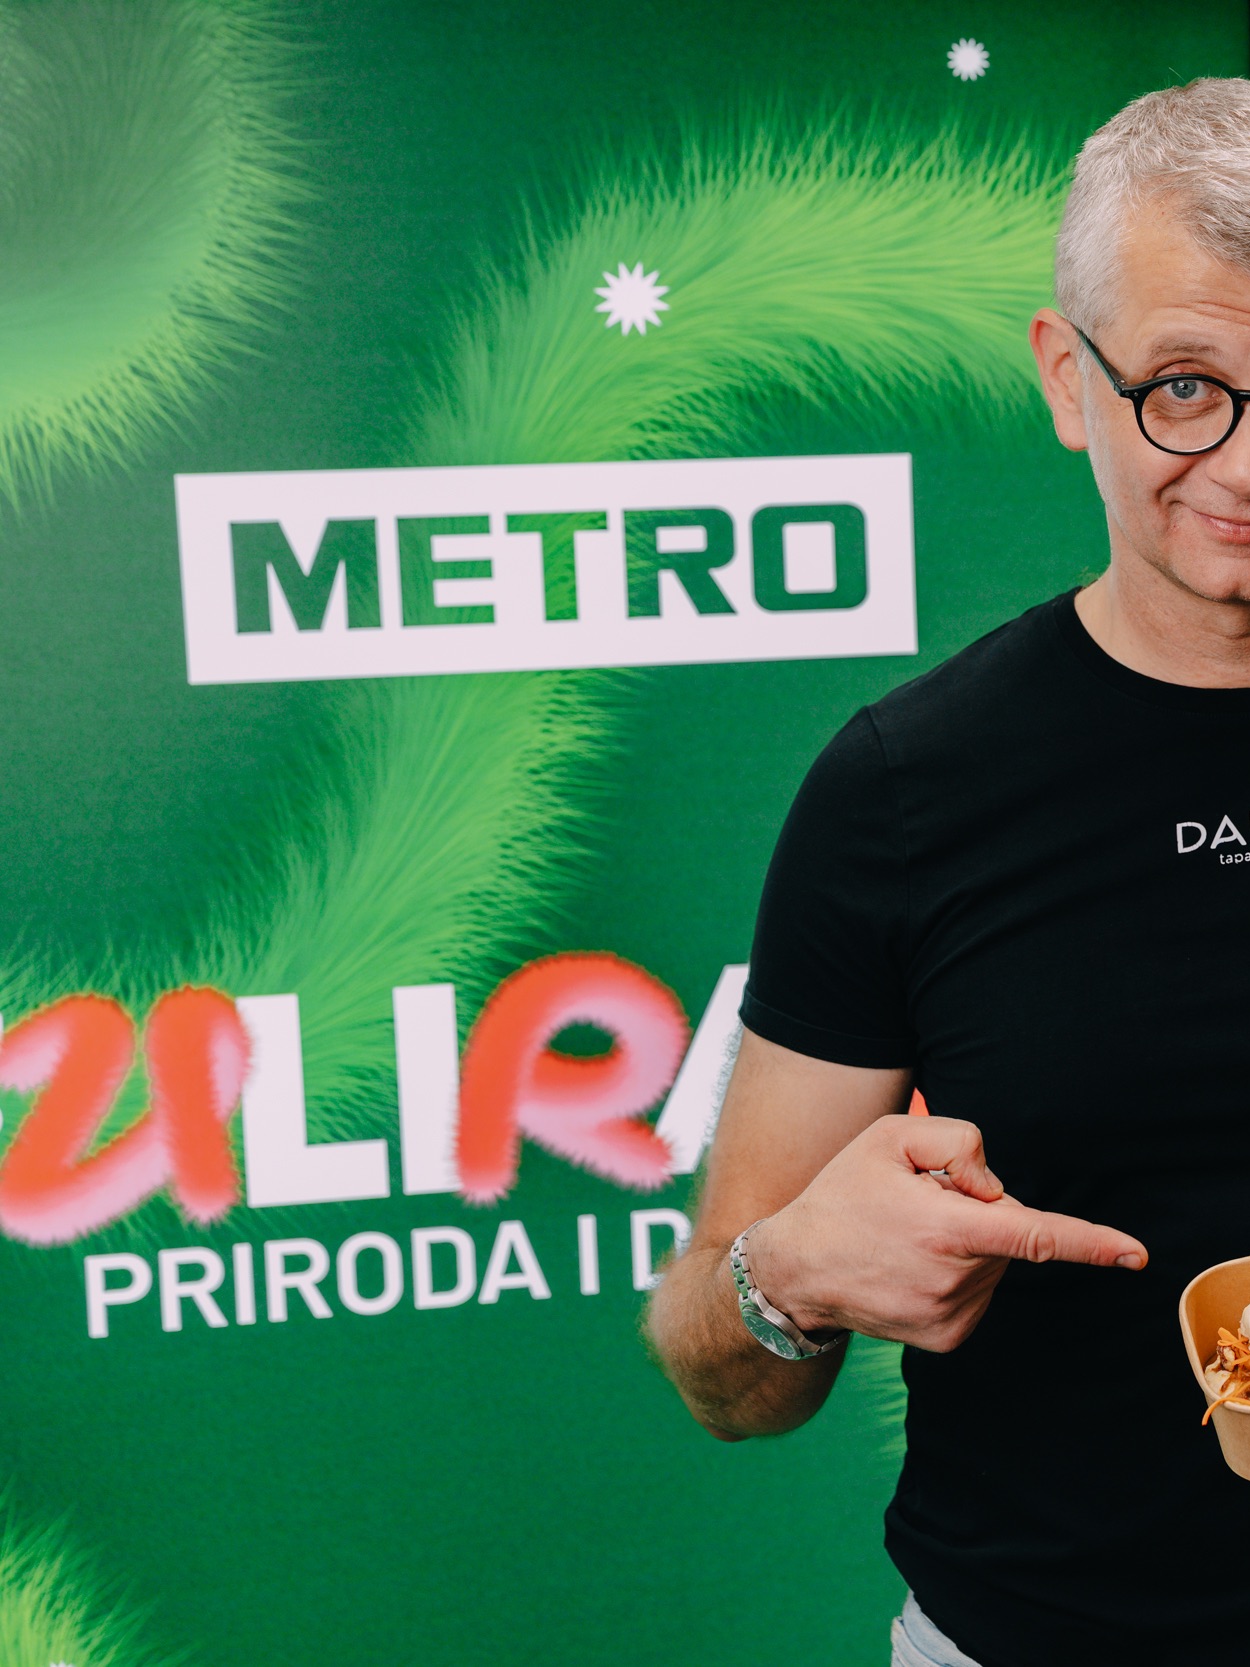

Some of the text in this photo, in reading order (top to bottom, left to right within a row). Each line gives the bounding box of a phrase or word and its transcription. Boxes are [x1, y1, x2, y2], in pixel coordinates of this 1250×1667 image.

[229, 501, 869, 634] METRO
[84, 1218, 551, 1339] PRIRODA
[577, 1213, 600, 1295] I
